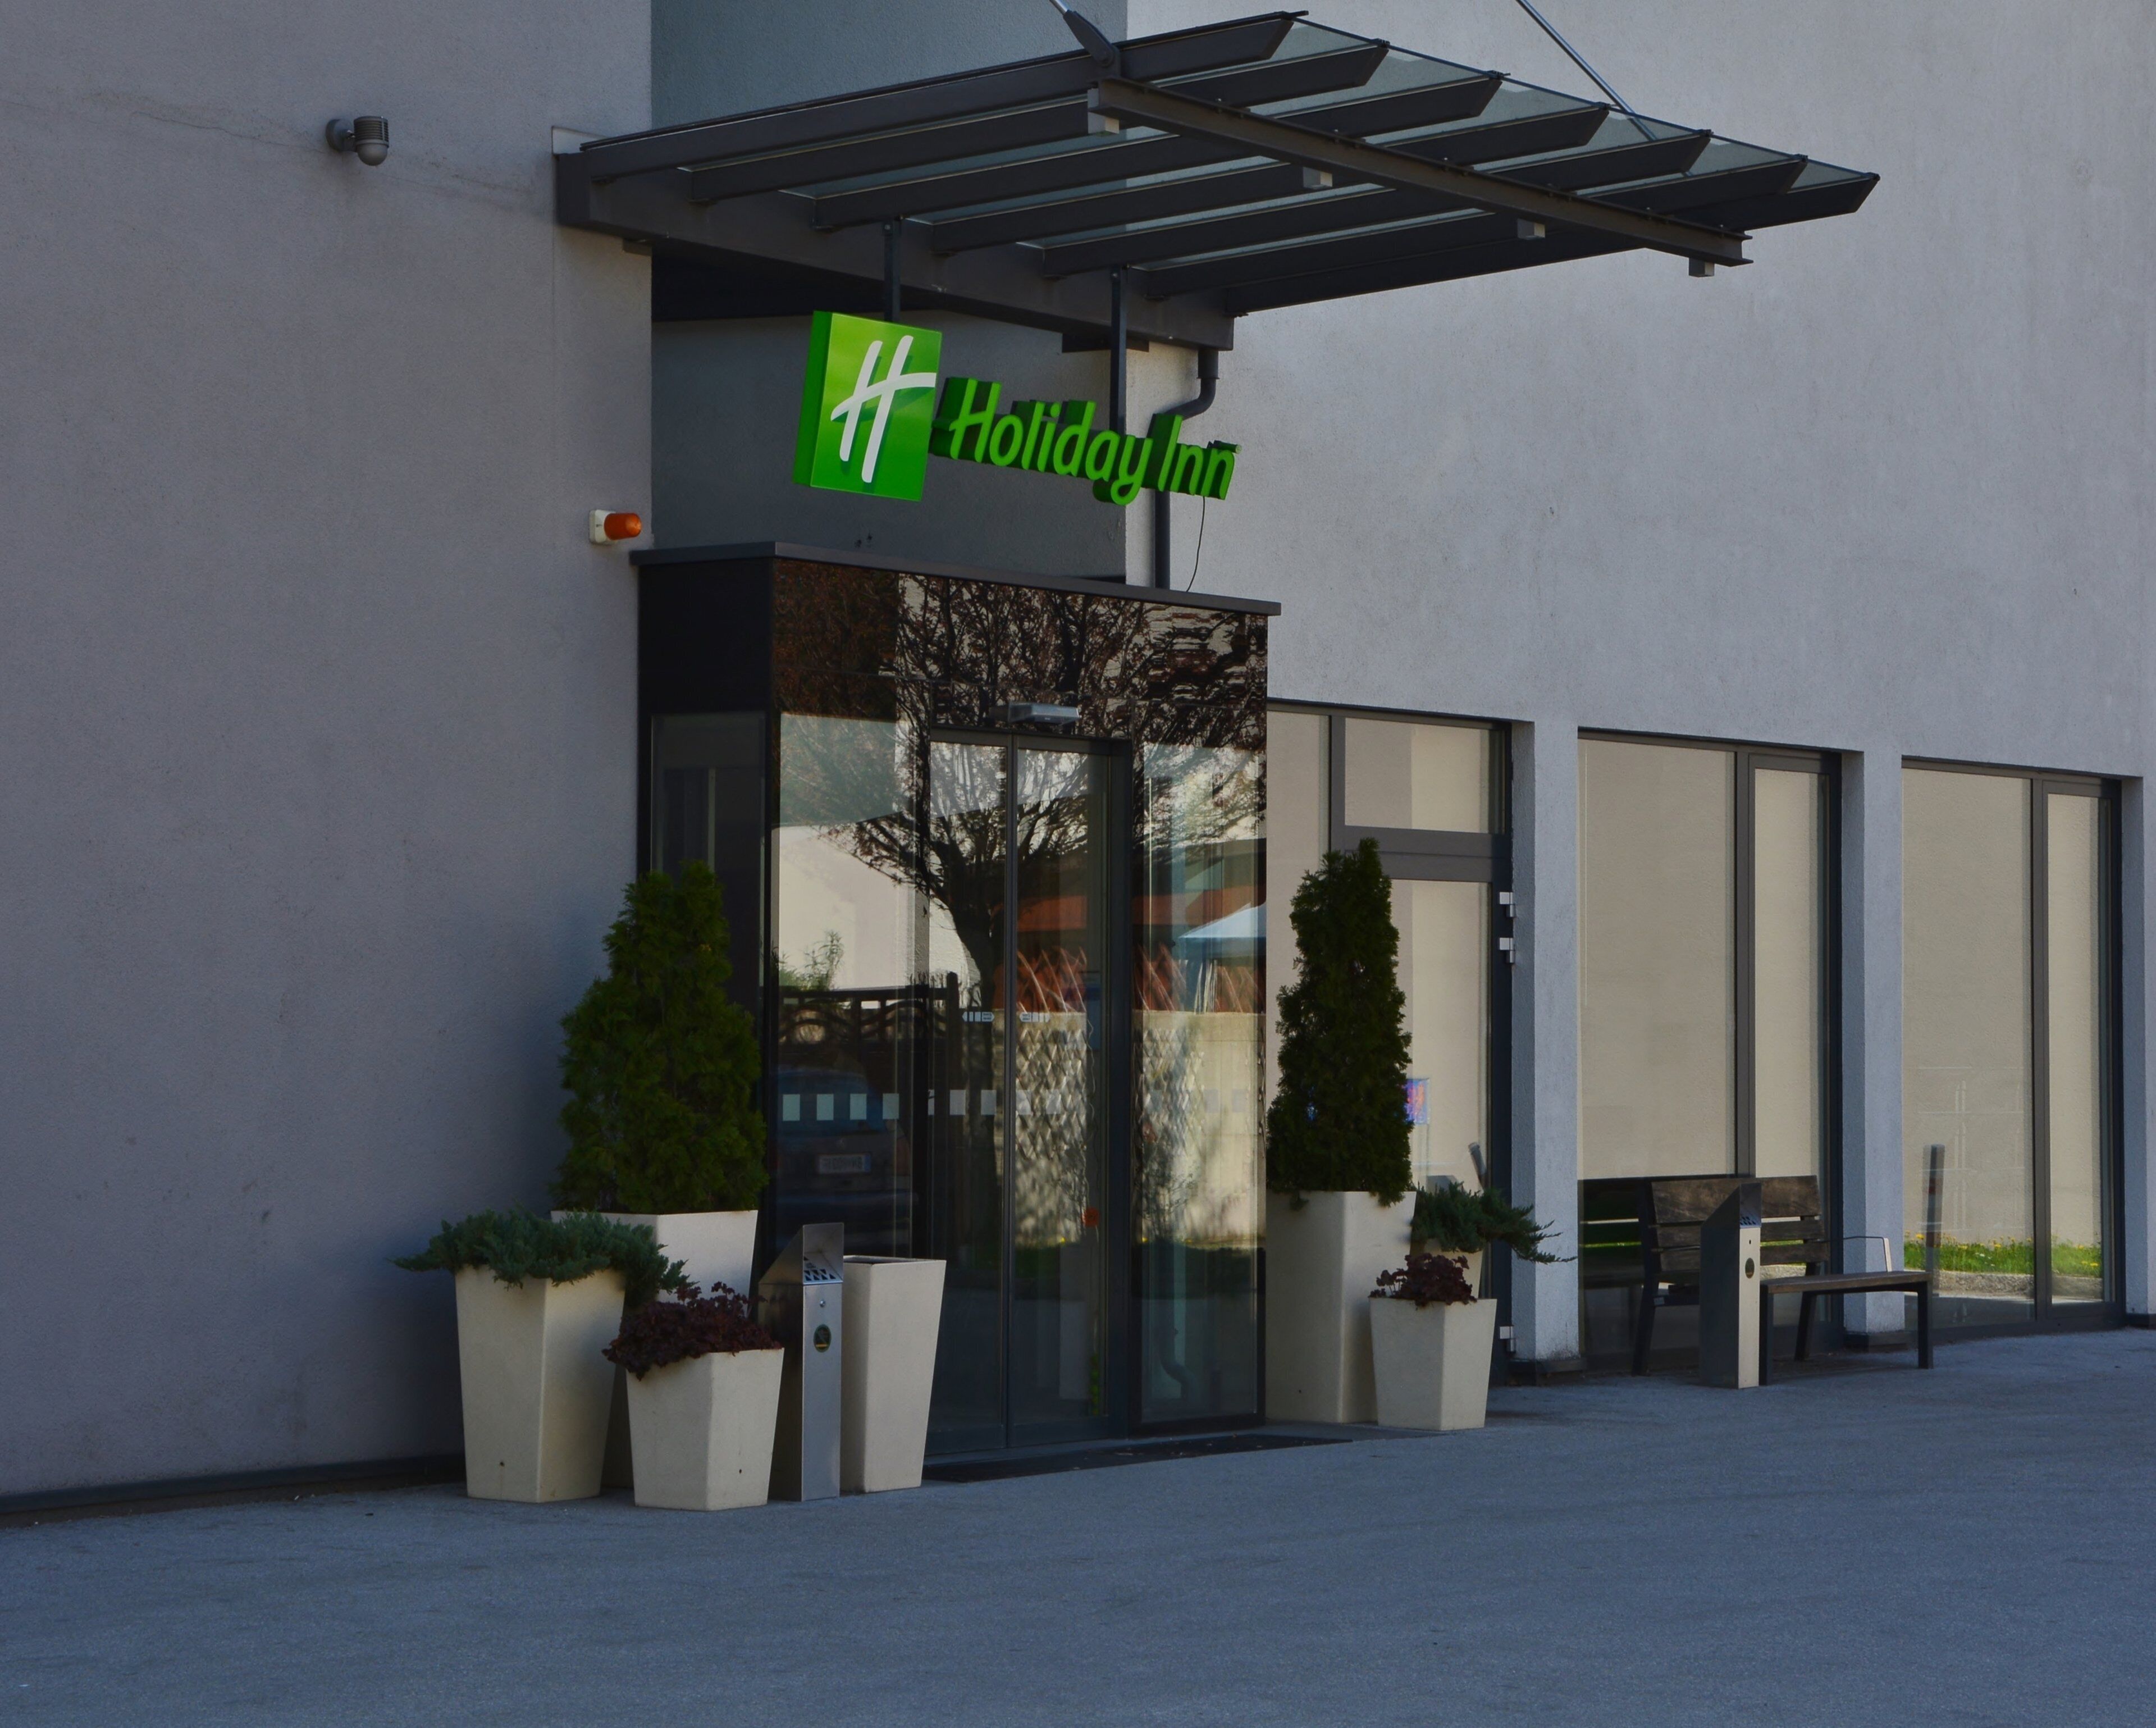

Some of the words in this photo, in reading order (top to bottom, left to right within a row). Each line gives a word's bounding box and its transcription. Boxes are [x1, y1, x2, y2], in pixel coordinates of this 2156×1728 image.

[831, 335, 937, 483] H
[949, 378, 1153, 505] Holiday
[1158, 414, 1235, 500] Inn
